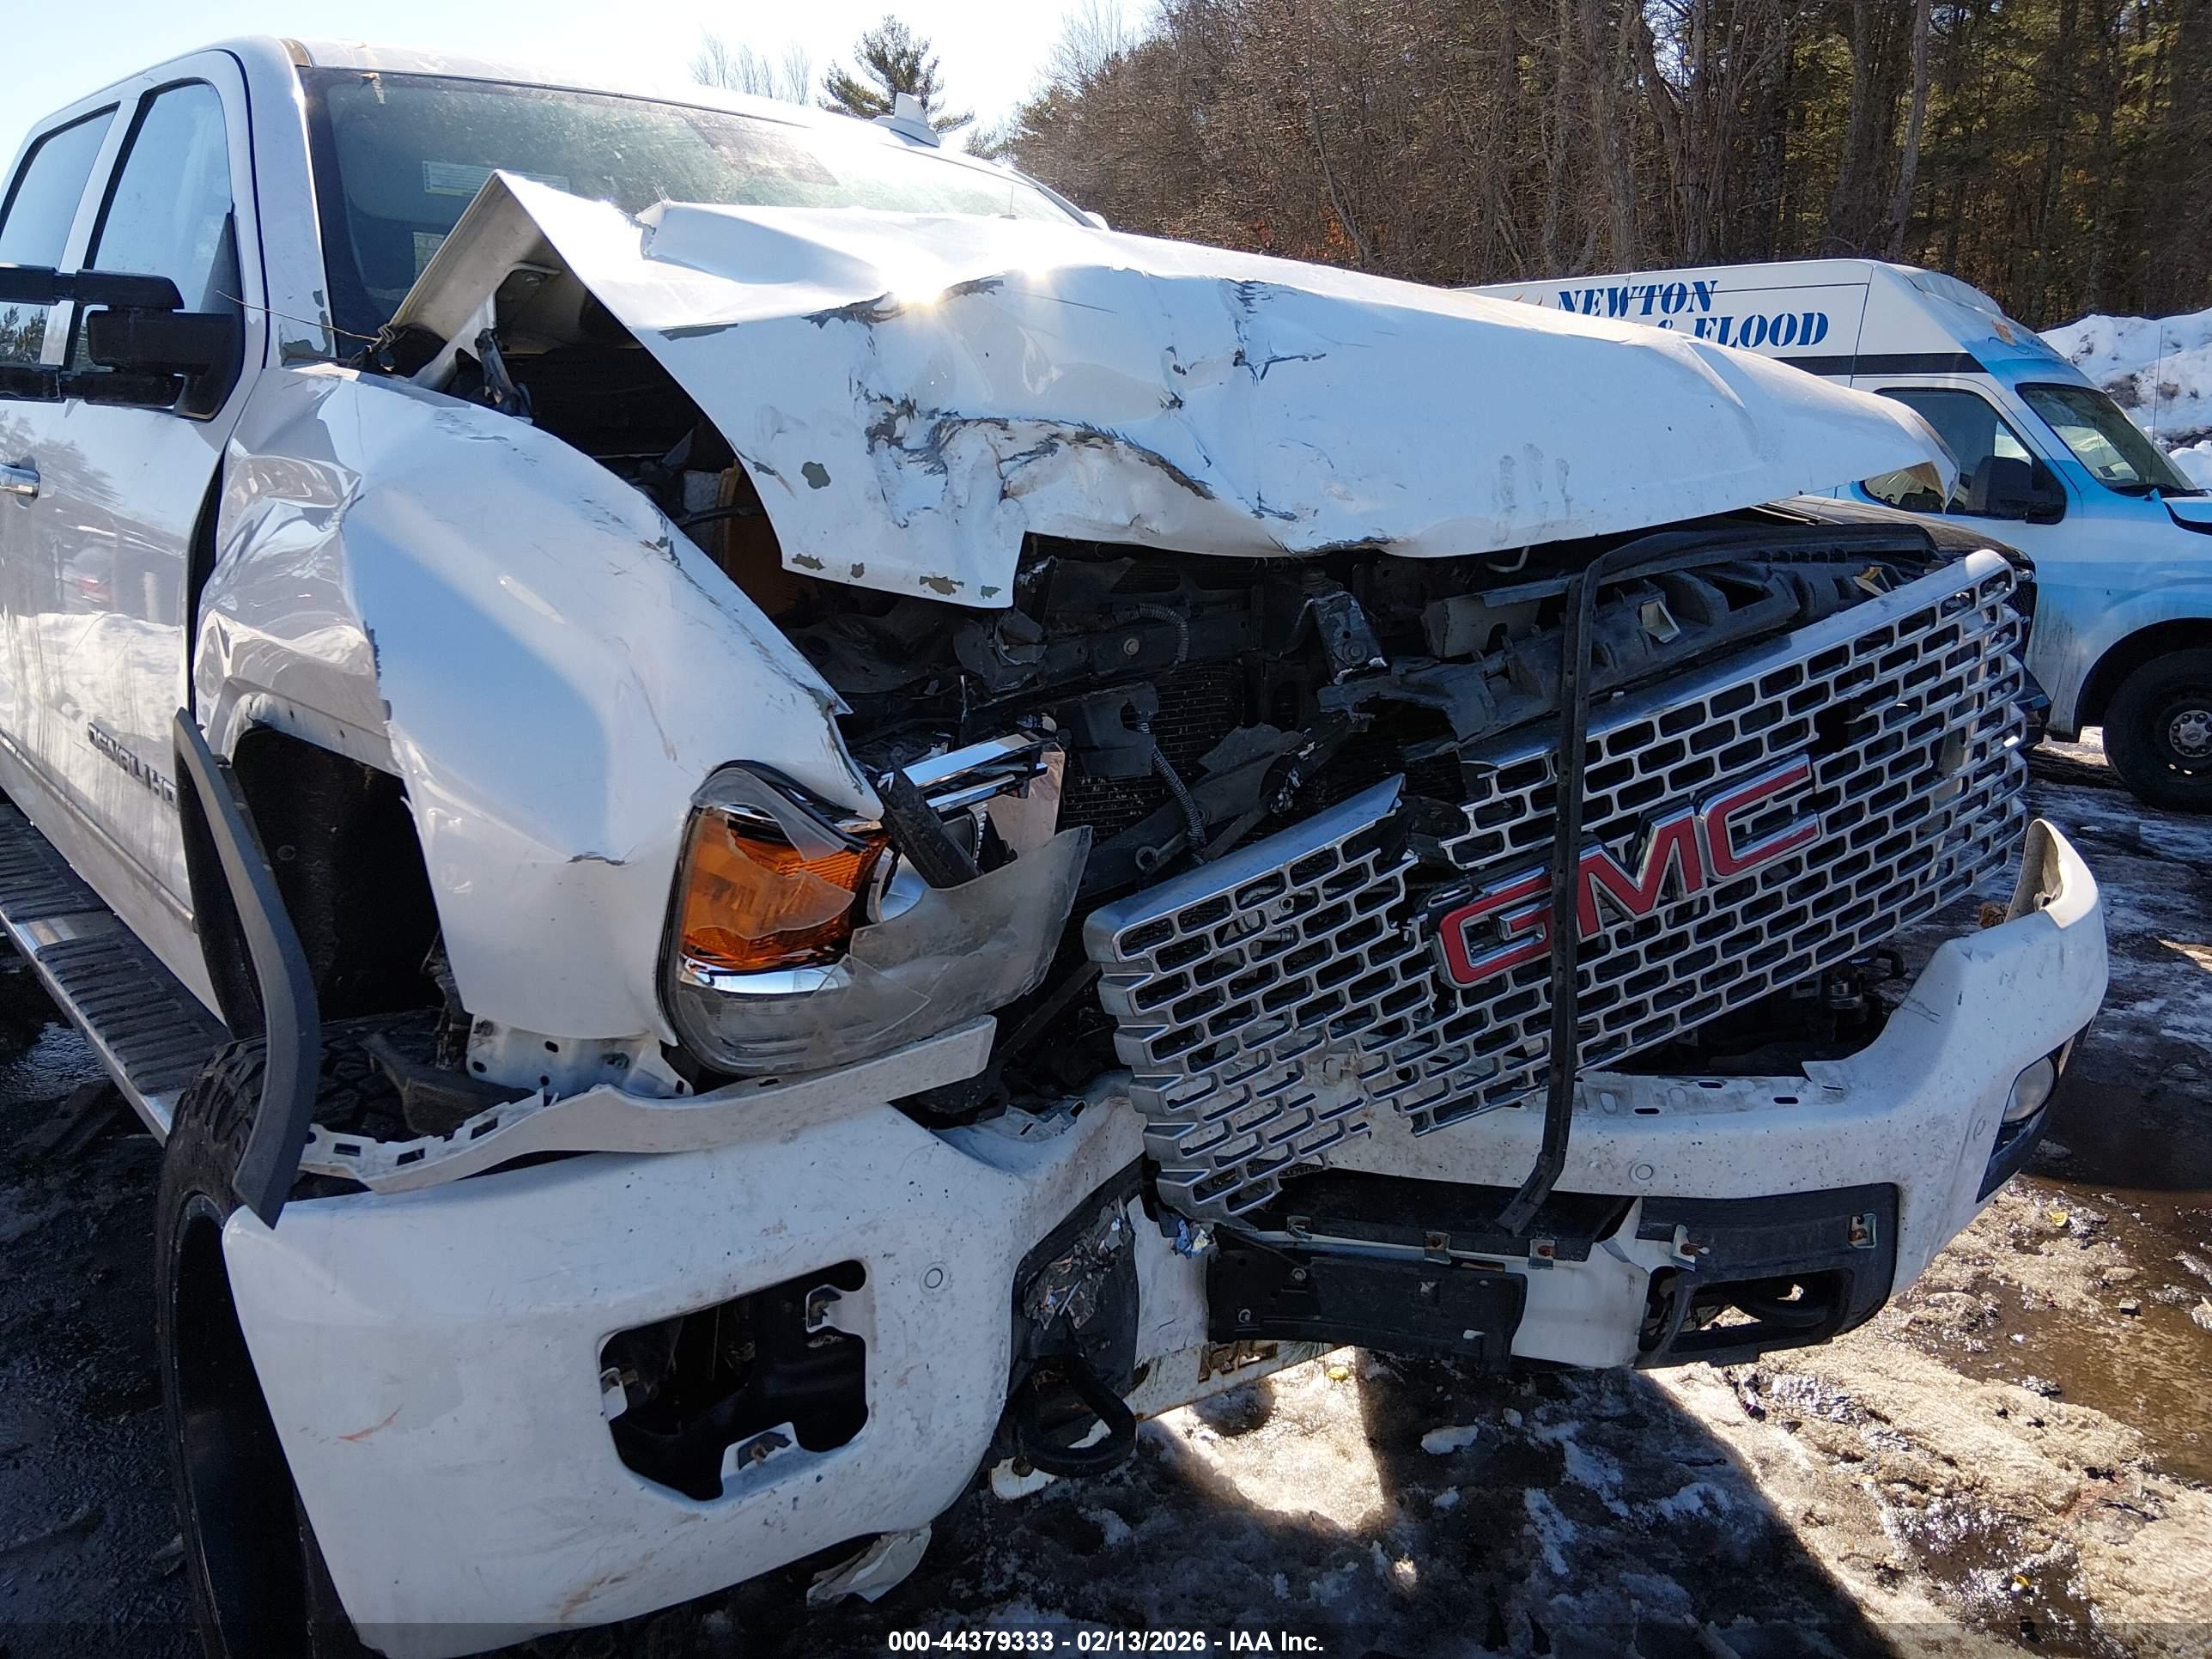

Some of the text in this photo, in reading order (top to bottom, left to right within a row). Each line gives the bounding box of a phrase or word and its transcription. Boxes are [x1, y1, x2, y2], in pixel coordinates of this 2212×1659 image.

[1558, 280, 1718, 318] NEWTON
[1694, 312, 1829, 349] FLOOD
[1437, 753, 1820, 988] GMC
